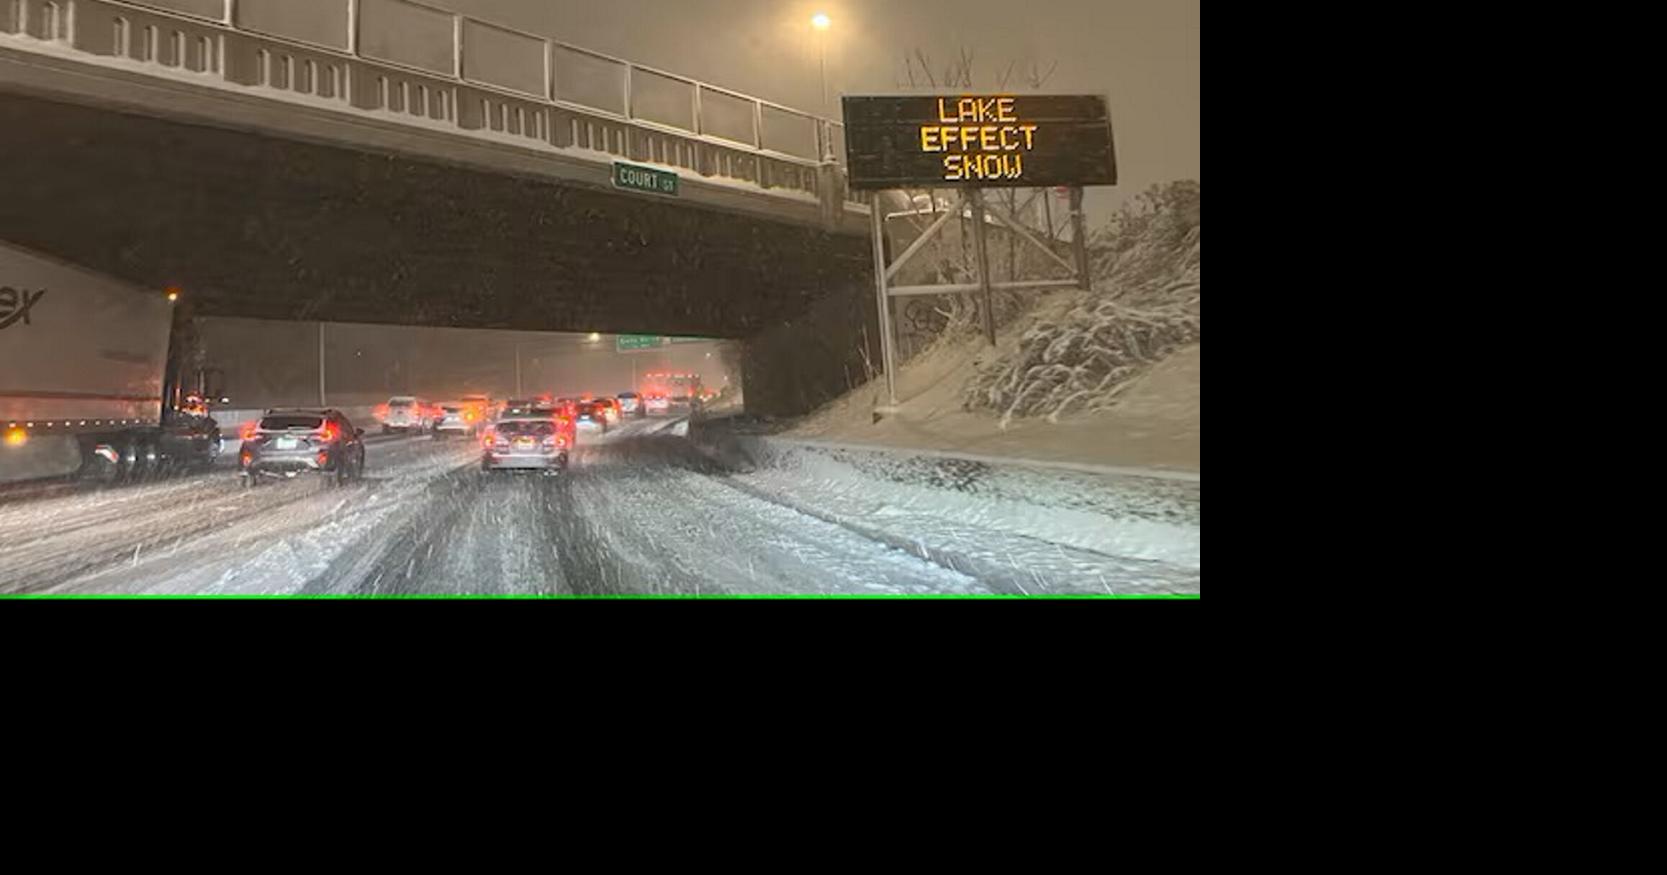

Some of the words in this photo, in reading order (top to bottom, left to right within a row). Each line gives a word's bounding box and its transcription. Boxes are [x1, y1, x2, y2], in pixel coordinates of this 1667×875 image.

[938, 97, 1017, 122] LAKE
[920, 125, 1038, 151] EFFECT
[620, 167, 658, 189] COURT
[944, 154, 1022, 179] SNOW
